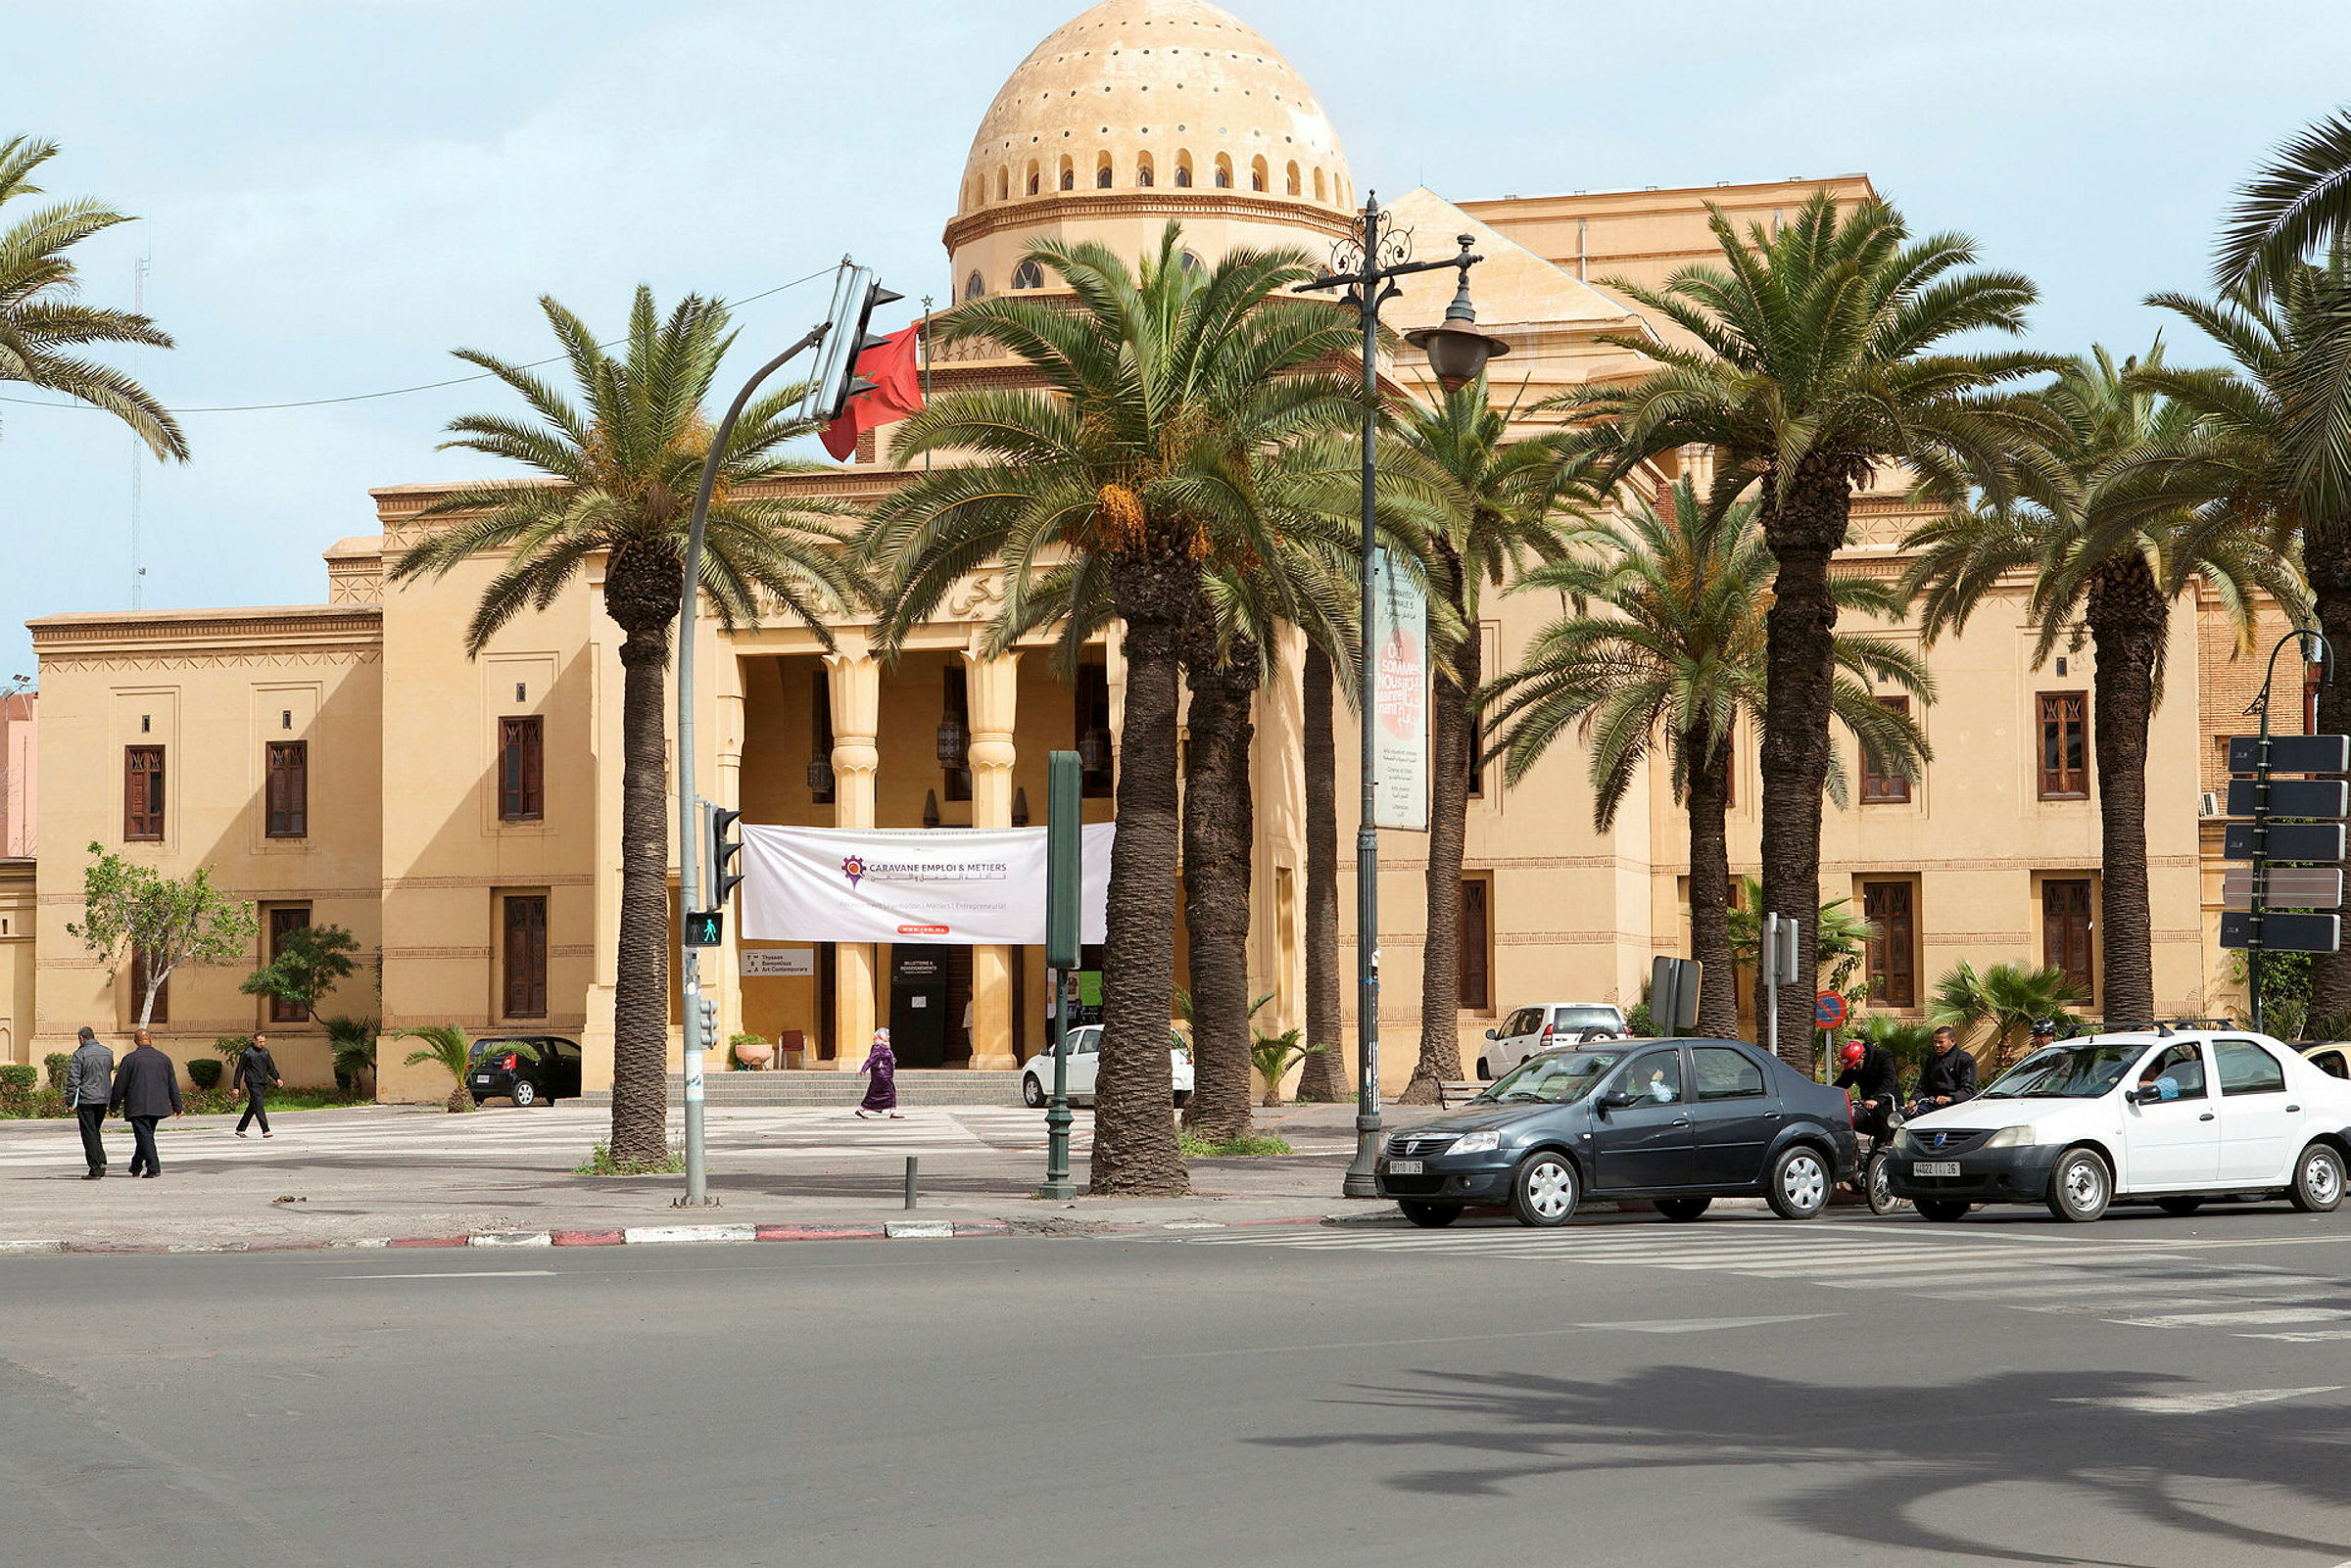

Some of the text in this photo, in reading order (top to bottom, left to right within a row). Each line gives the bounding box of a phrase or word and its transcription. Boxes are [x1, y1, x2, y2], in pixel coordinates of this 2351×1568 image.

[869, 863, 920, 873] CARAVANE
[921, 863, 956, 872] EMPLOI
[958, 863, 965, 872] &
[1947, 1164, 1956, 1174] 26
